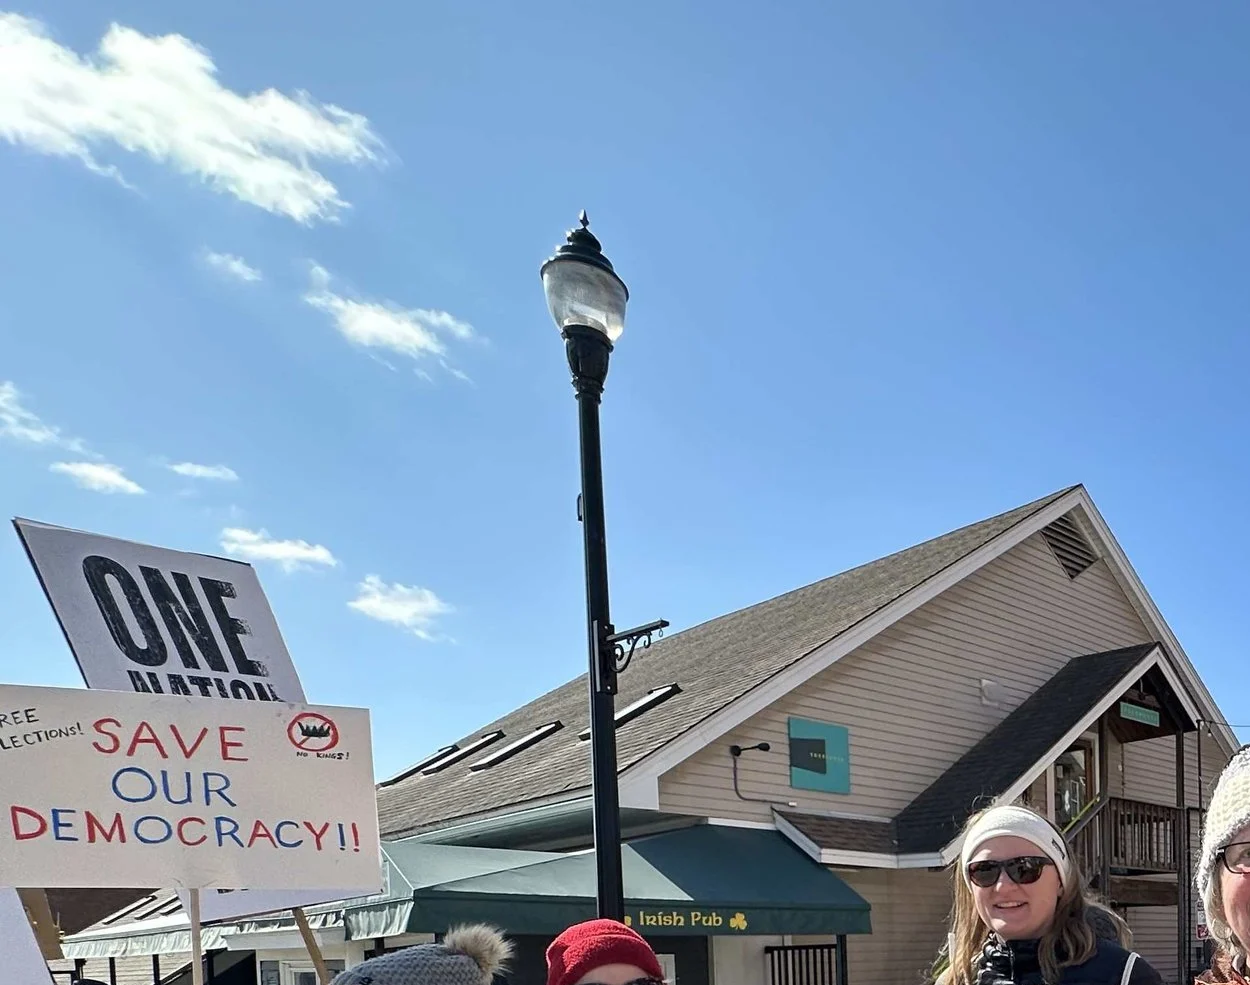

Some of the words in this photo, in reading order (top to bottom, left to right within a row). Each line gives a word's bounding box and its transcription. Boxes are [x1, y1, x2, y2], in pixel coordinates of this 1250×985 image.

[82, 554, 270, 677] ONE
[92, 717, 249, 762] SAVE
[316, 752, 350, 760] KINGS!
[112, 766, 237, 807] OUR
[10, 805, 361, 853] DEMOCRACY!!
[639, 910, 684, 927] Irish
[690, 911, 723, 927] Pub
